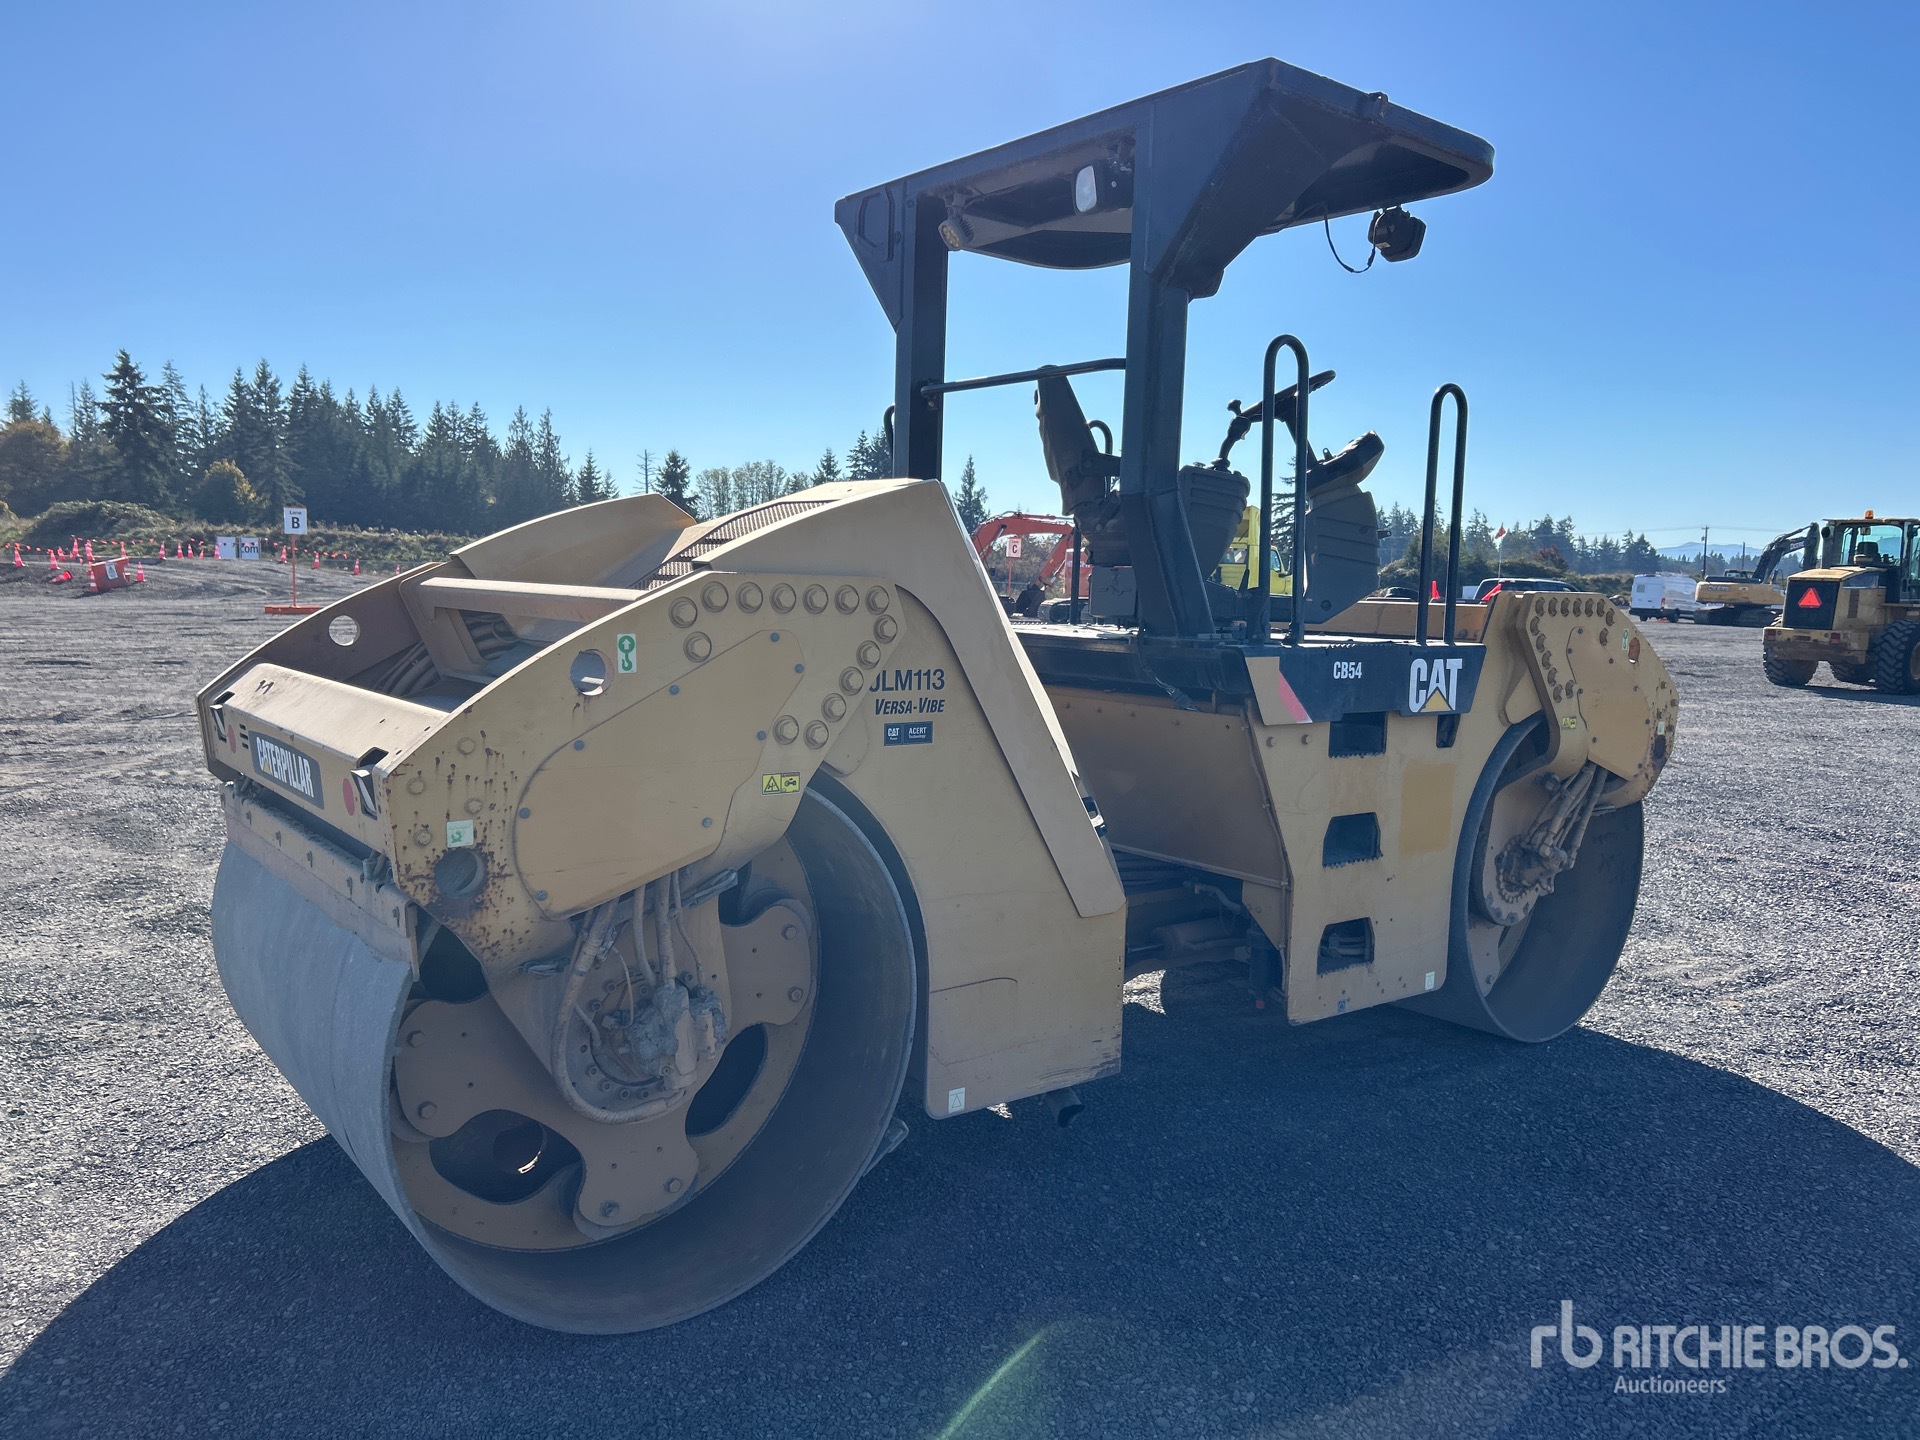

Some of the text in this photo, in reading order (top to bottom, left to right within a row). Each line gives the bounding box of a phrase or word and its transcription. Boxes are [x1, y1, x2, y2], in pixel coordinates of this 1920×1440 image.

[291, 516, 301, 529] B
[1012, 544, 1018, 553] C
[1333, 661, 1362, 679] CB54
[869, 668, 945, 692] JLM113
[1409, 658, 1462, 713] CAT
[887, 727, 900, 737] CAT
[908, 727, 927, 735] ACERT
[256, 736, 314, 798] CATERPILLAR
